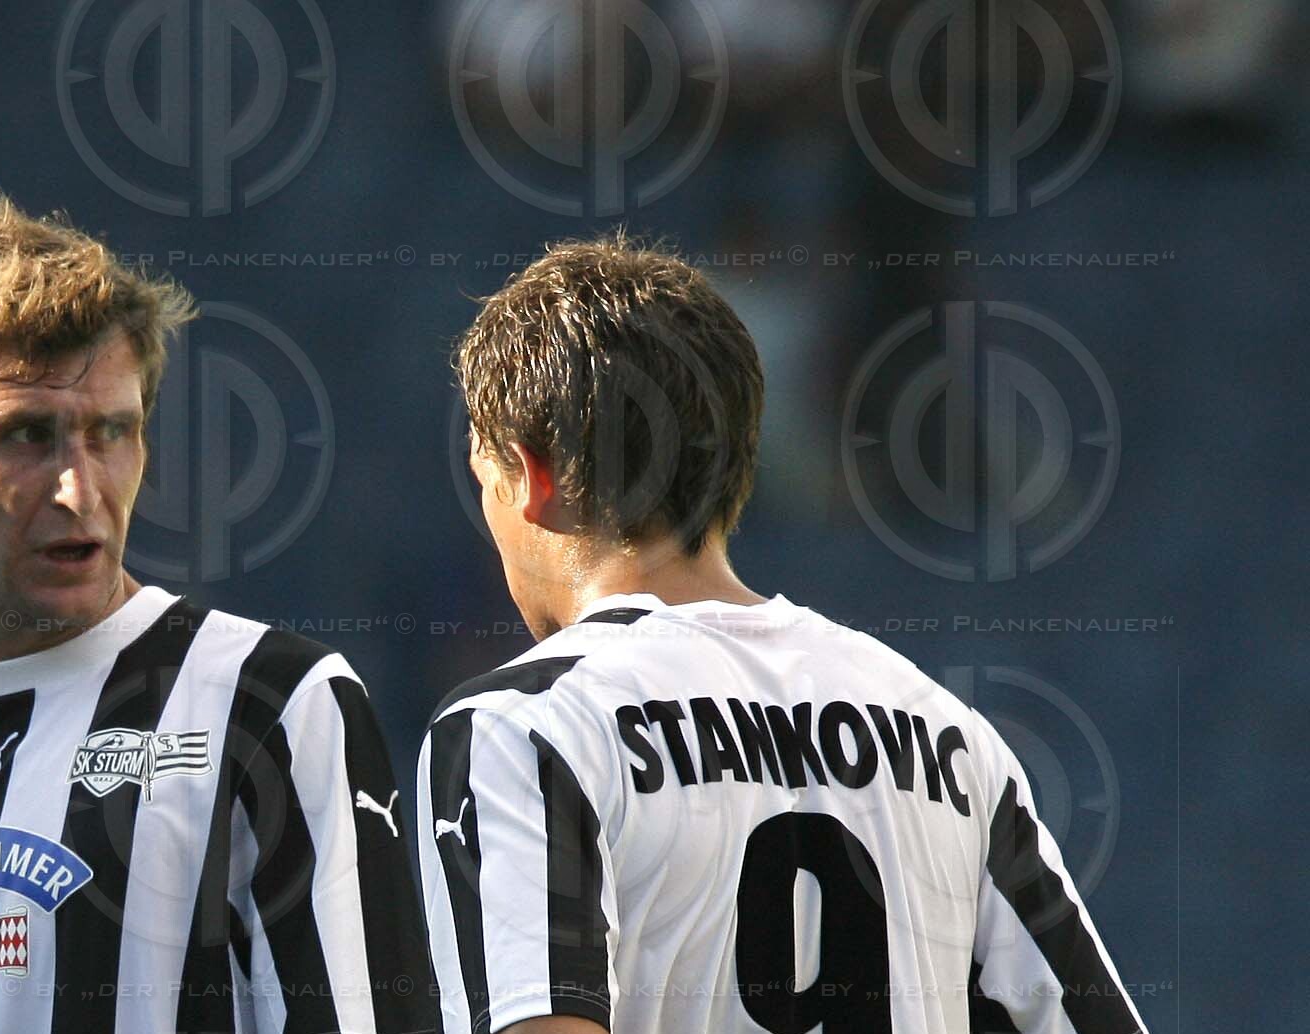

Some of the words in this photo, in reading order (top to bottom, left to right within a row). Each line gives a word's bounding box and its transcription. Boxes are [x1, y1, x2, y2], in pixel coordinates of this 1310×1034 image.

[73, 751, 94, 777] SK
[94, 750, 145, 776] STURM
[615, 697, 970, 817] STANKOVIC
